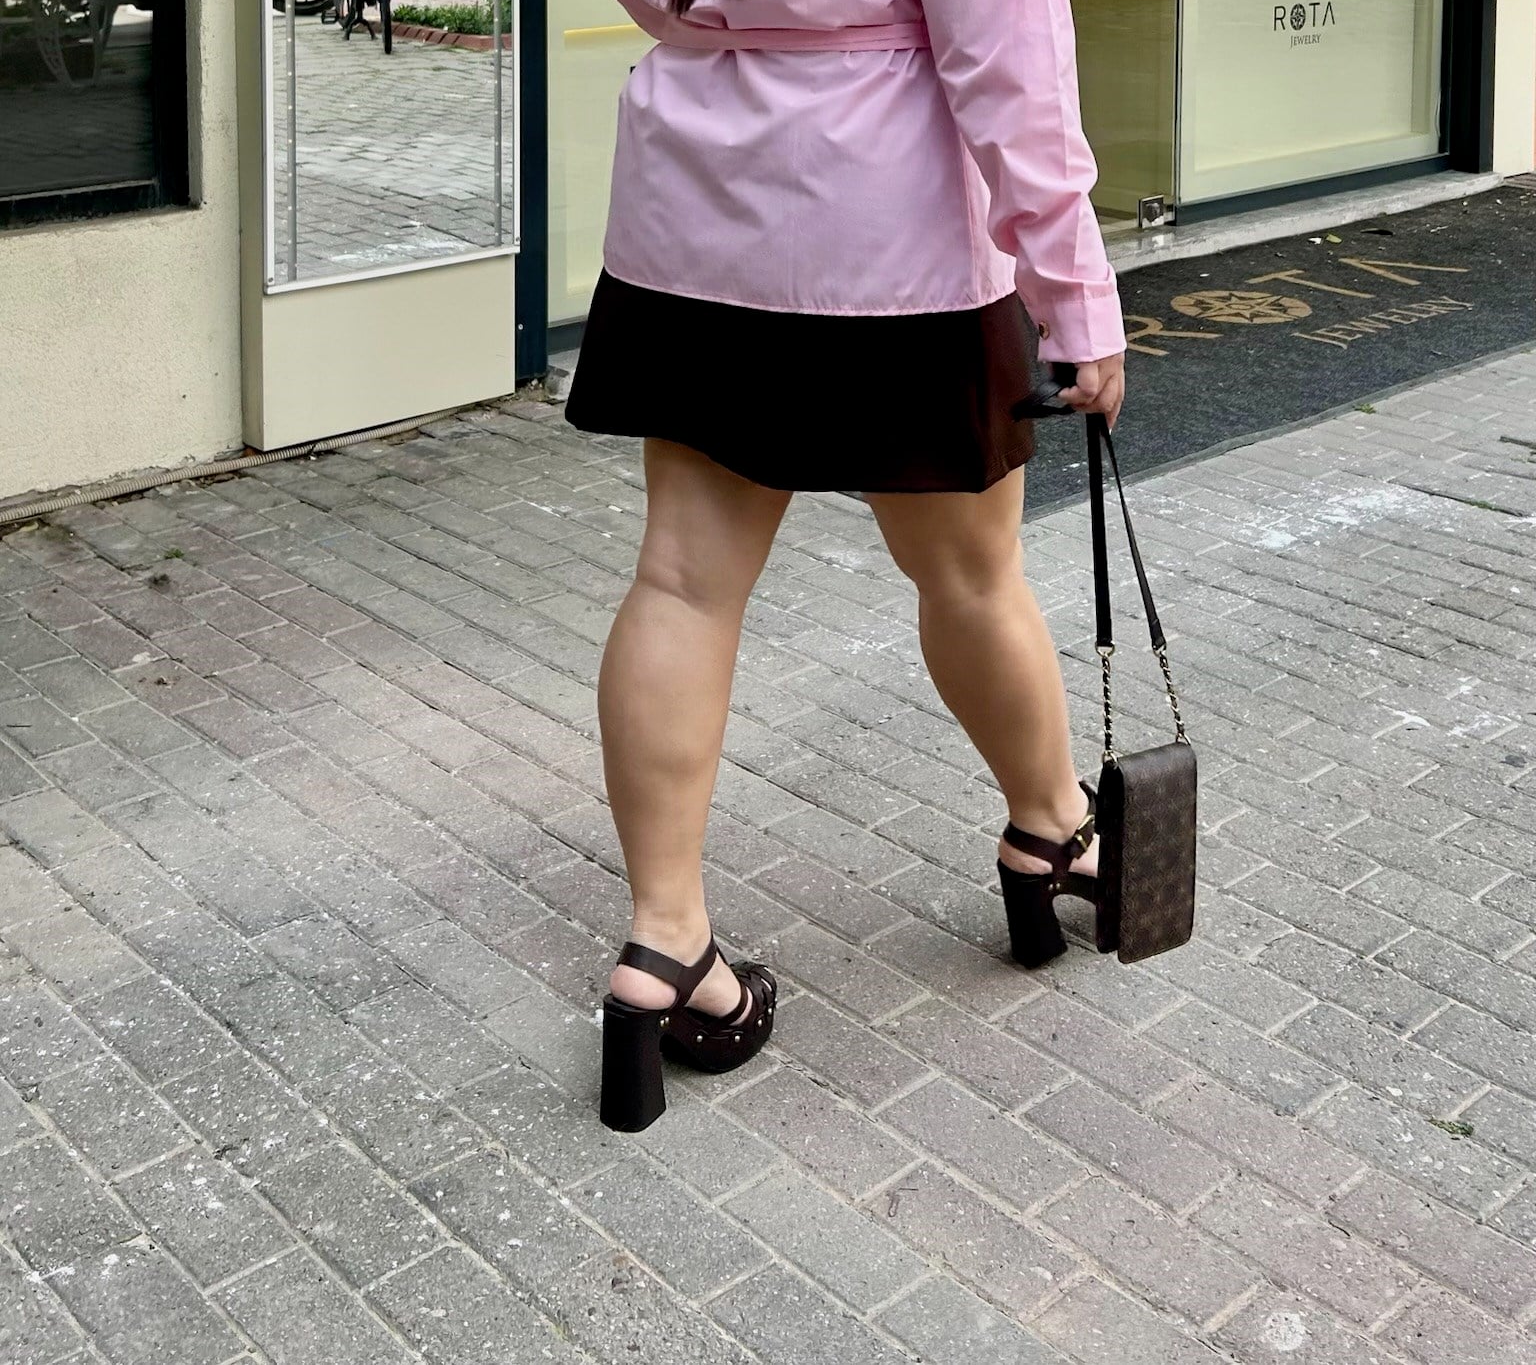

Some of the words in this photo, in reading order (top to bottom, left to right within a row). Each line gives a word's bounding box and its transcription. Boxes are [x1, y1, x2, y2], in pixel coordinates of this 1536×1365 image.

[1273, 1, 1336, 31] ROTA
[1290, 34, 1321, 49] JEWELRY
[1290, 296, 1475, 349] JEWELRY
